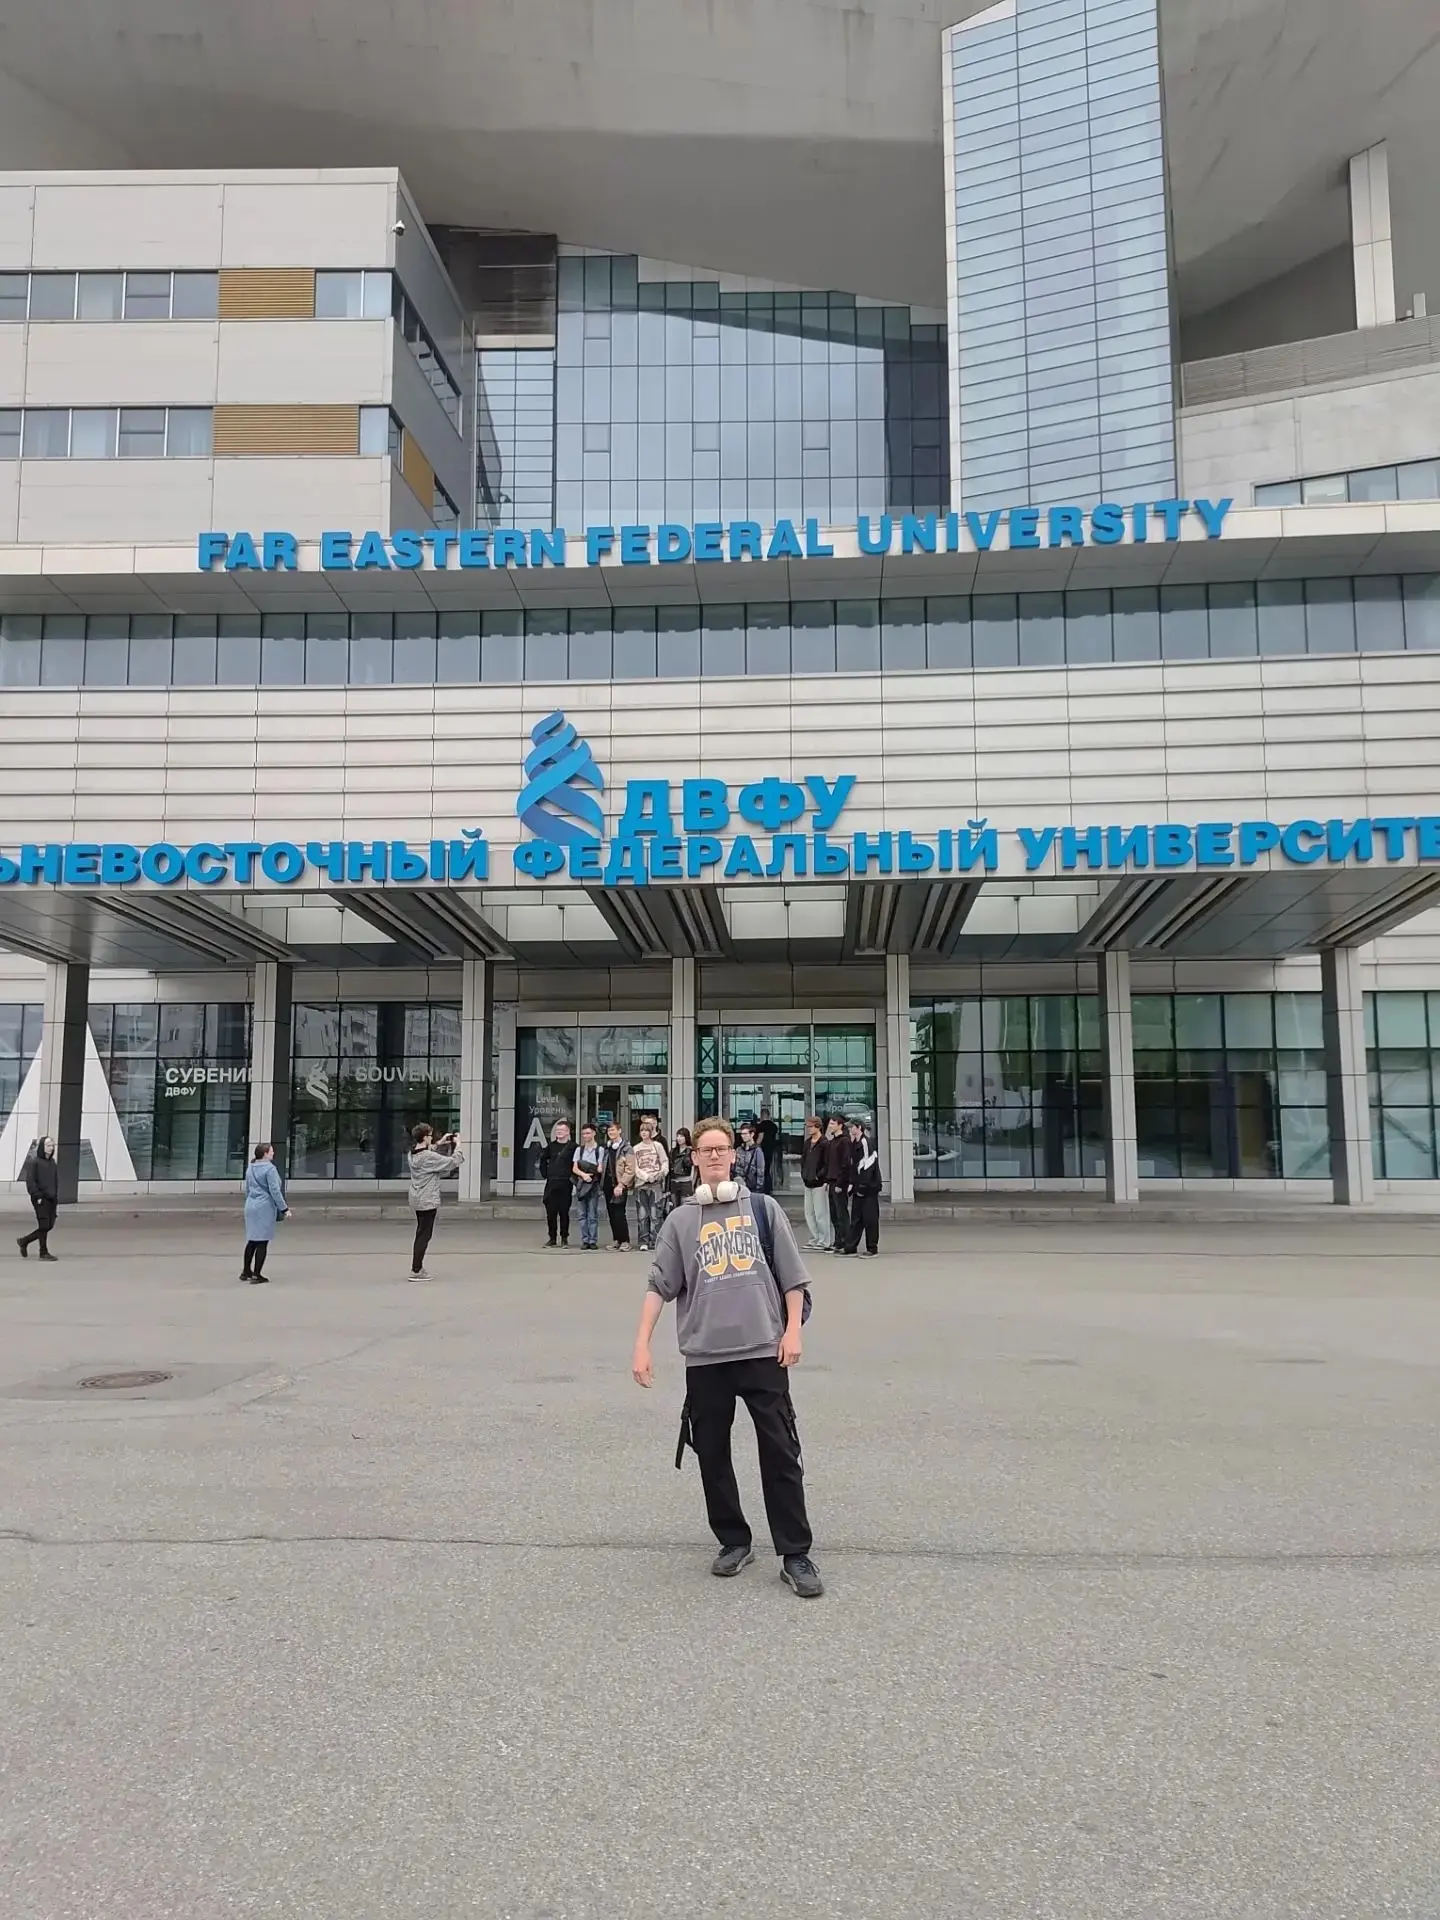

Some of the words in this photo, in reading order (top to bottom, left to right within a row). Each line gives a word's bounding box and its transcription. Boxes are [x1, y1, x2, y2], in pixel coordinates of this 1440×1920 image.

[199, 531, 298, 574] FAR
[321, 525, 566, 572] EASTERN
[587, 517, 834, 568] FEDERAL
[857, 498, 1233, 555] UNIVERSITY
[617, 774, 857, 838] ДВФУ
[513, 819, 999, 886] ФЕДЕРАЛЬНЫЙ
[1018, 816, 1440, 872] УНИВЕРСИТЕ
[164, 1086, 196, 1098] ДВФУ
[165, 1067, 252, 1083] СУВЕНИ
[536, 1095, 559, 1103] Level
